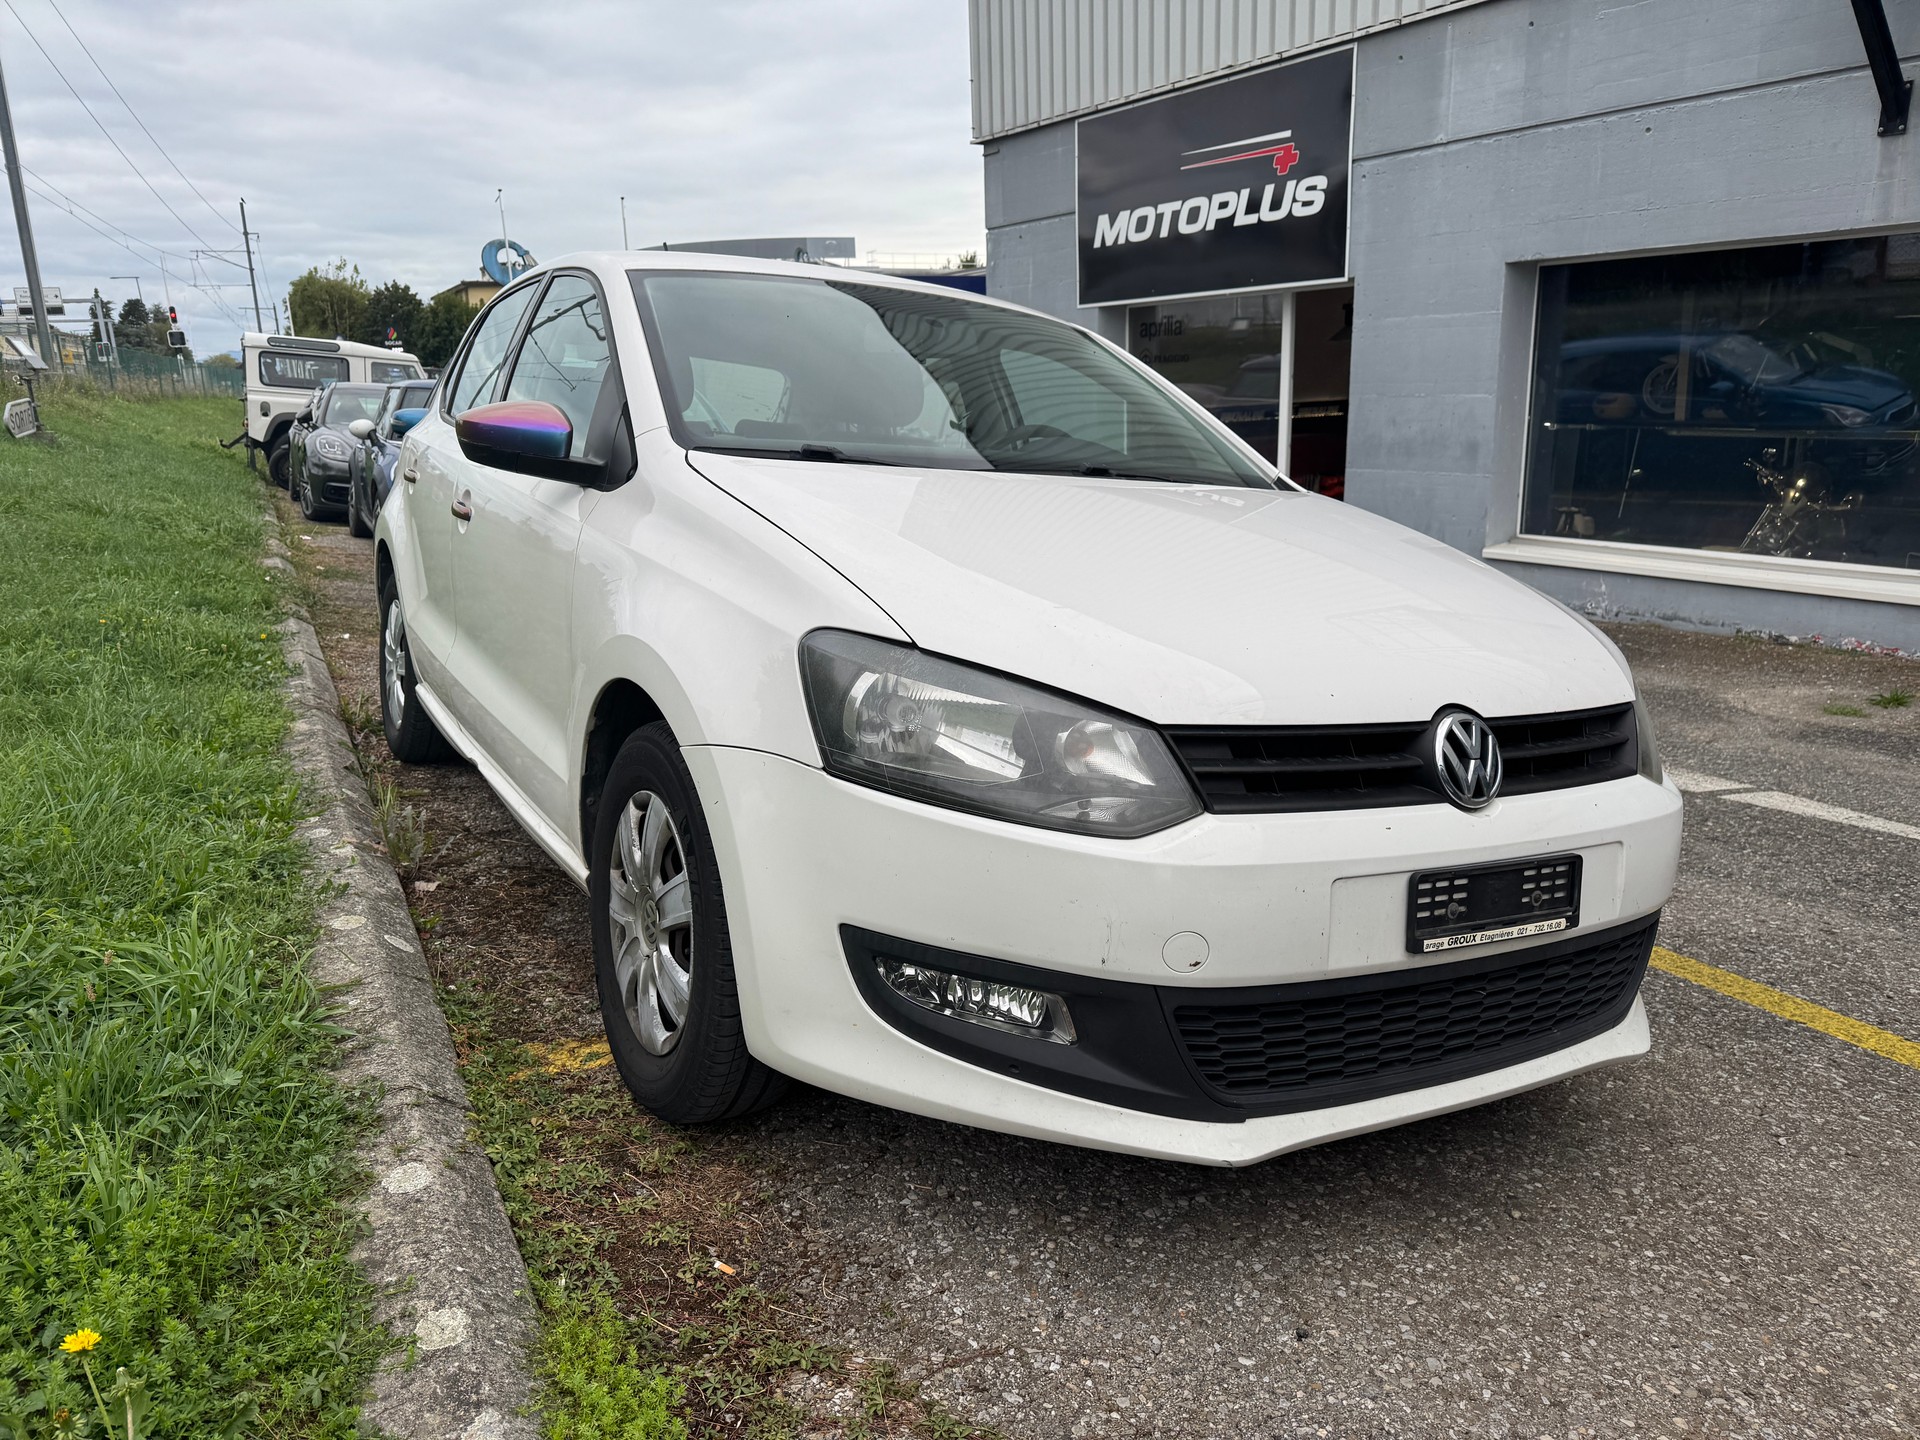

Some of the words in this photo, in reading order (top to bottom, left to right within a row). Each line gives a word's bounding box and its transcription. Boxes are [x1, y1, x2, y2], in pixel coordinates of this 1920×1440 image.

[1093, 175, 1328, 248] MOTOPLUS
[1139, 315, 1183, 341] aprilia
[1447, 934, 1478, 946] GROUX
[1517, 927, 1528, 936] 021
